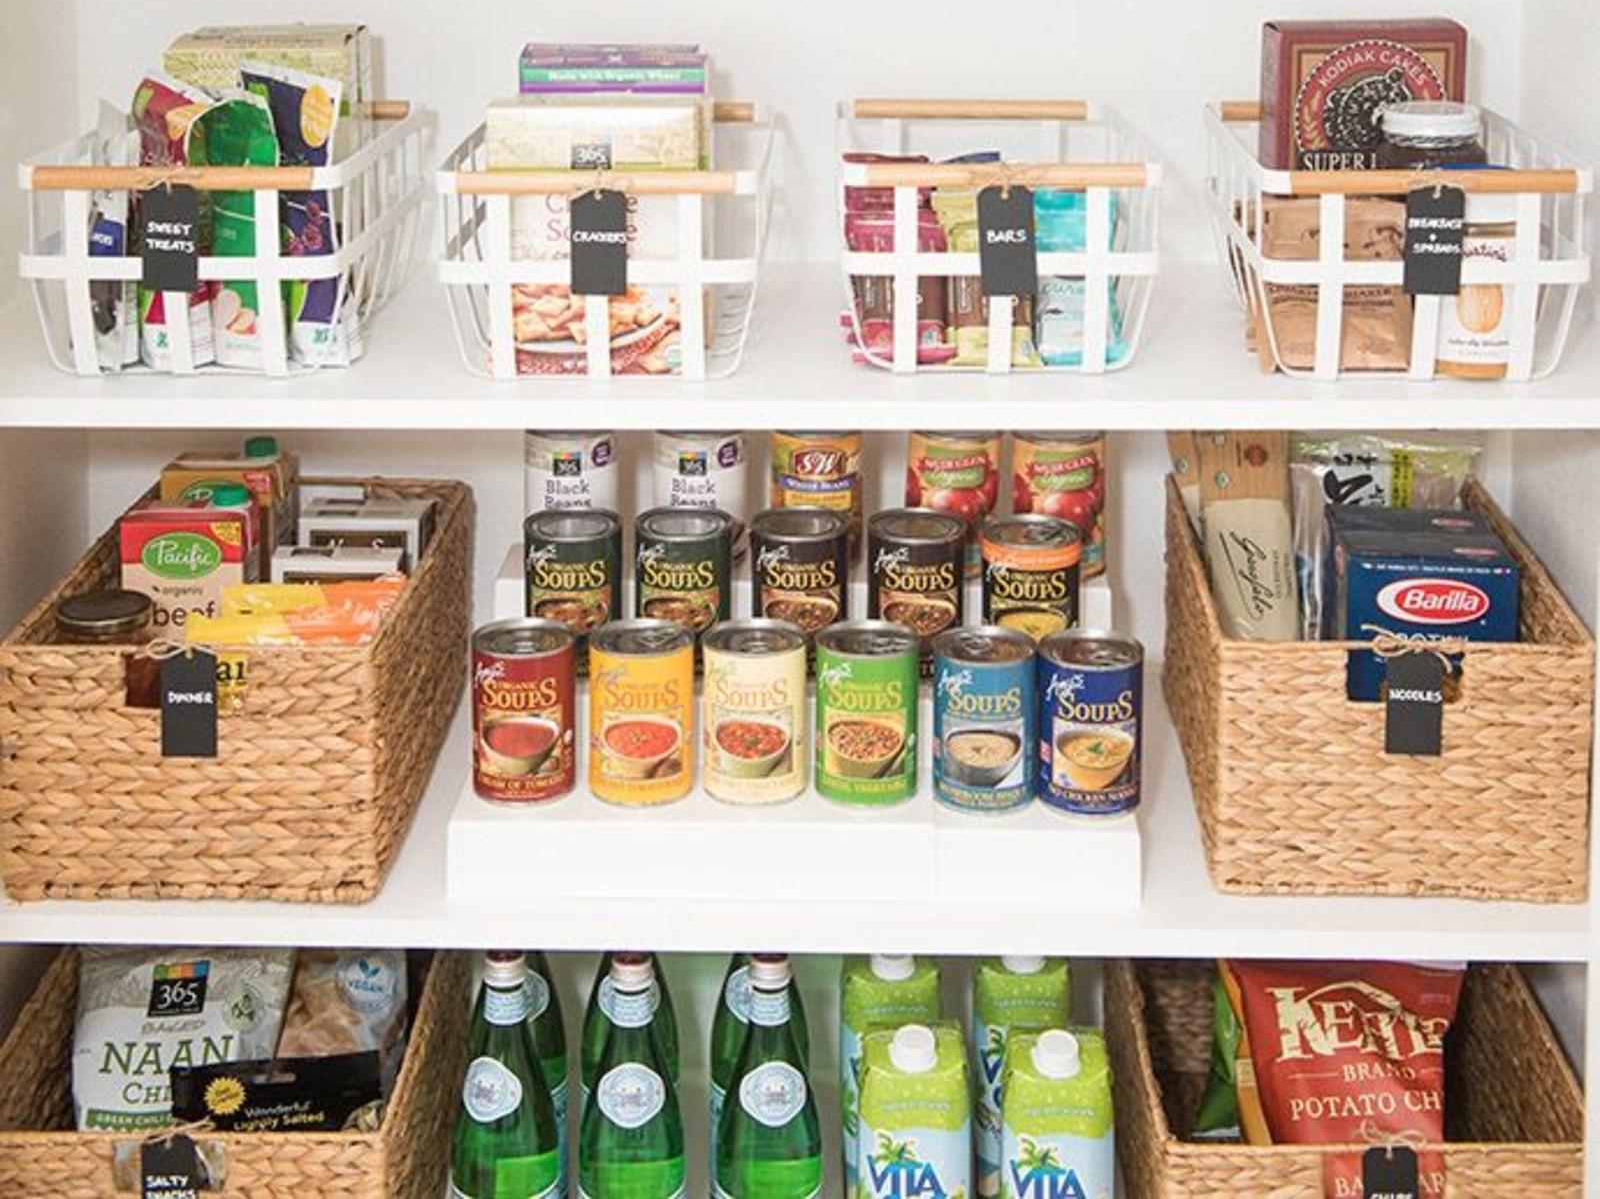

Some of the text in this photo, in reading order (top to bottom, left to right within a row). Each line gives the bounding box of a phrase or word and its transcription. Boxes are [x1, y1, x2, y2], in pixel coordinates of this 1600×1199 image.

[1318, 50, 1430, 88] KODIAK CAKES
[1303, 152, 1366, 172] SUPER
[147, 221, 192, 237] SWEET
[986, 230, 1027, 244] BARS
[146, 237, 195, 254] TREATS
[545, 479, 590, 495] Black
[671, 478, 716, 495] Black
[150, 540, 214, 572] Pacific
[535, 560, 606, 588] SOUPS
[644, 560, 714, 588] SOUPS
[766, 560, 836, 589] SOUPS
[885, 563, 955, 591] SOUPS
[994, 571, 1067, 599] SOUPS
[152, 600, 215, 627] bef
[1402, 588, 1480, 612] Barilla
[168, 691, 214, 704] DINNER
[482, 677, 558, 709] SOUPS
[604, 679, 681, 710] SOUPS
[828, 681, 902, 710] SOUPS
[948, 687, 1022, 714] SOUPS
[1057, 690, 1134, 722] SOUPS
[157, 981, 199, 1009] 365
[99, 1035, 234, 1076] NAAN
[1342, 1062, 1417, 1082] BRAND
[122, 1082, 172, 1104] CHI
[1290, 1092, 1397, 1121] POTATO
[145, 1174, 189, 1189] SALTY
[866, 1153, 947, 1195] VITA
[1009, 1159, 1088, 1199] VITA
